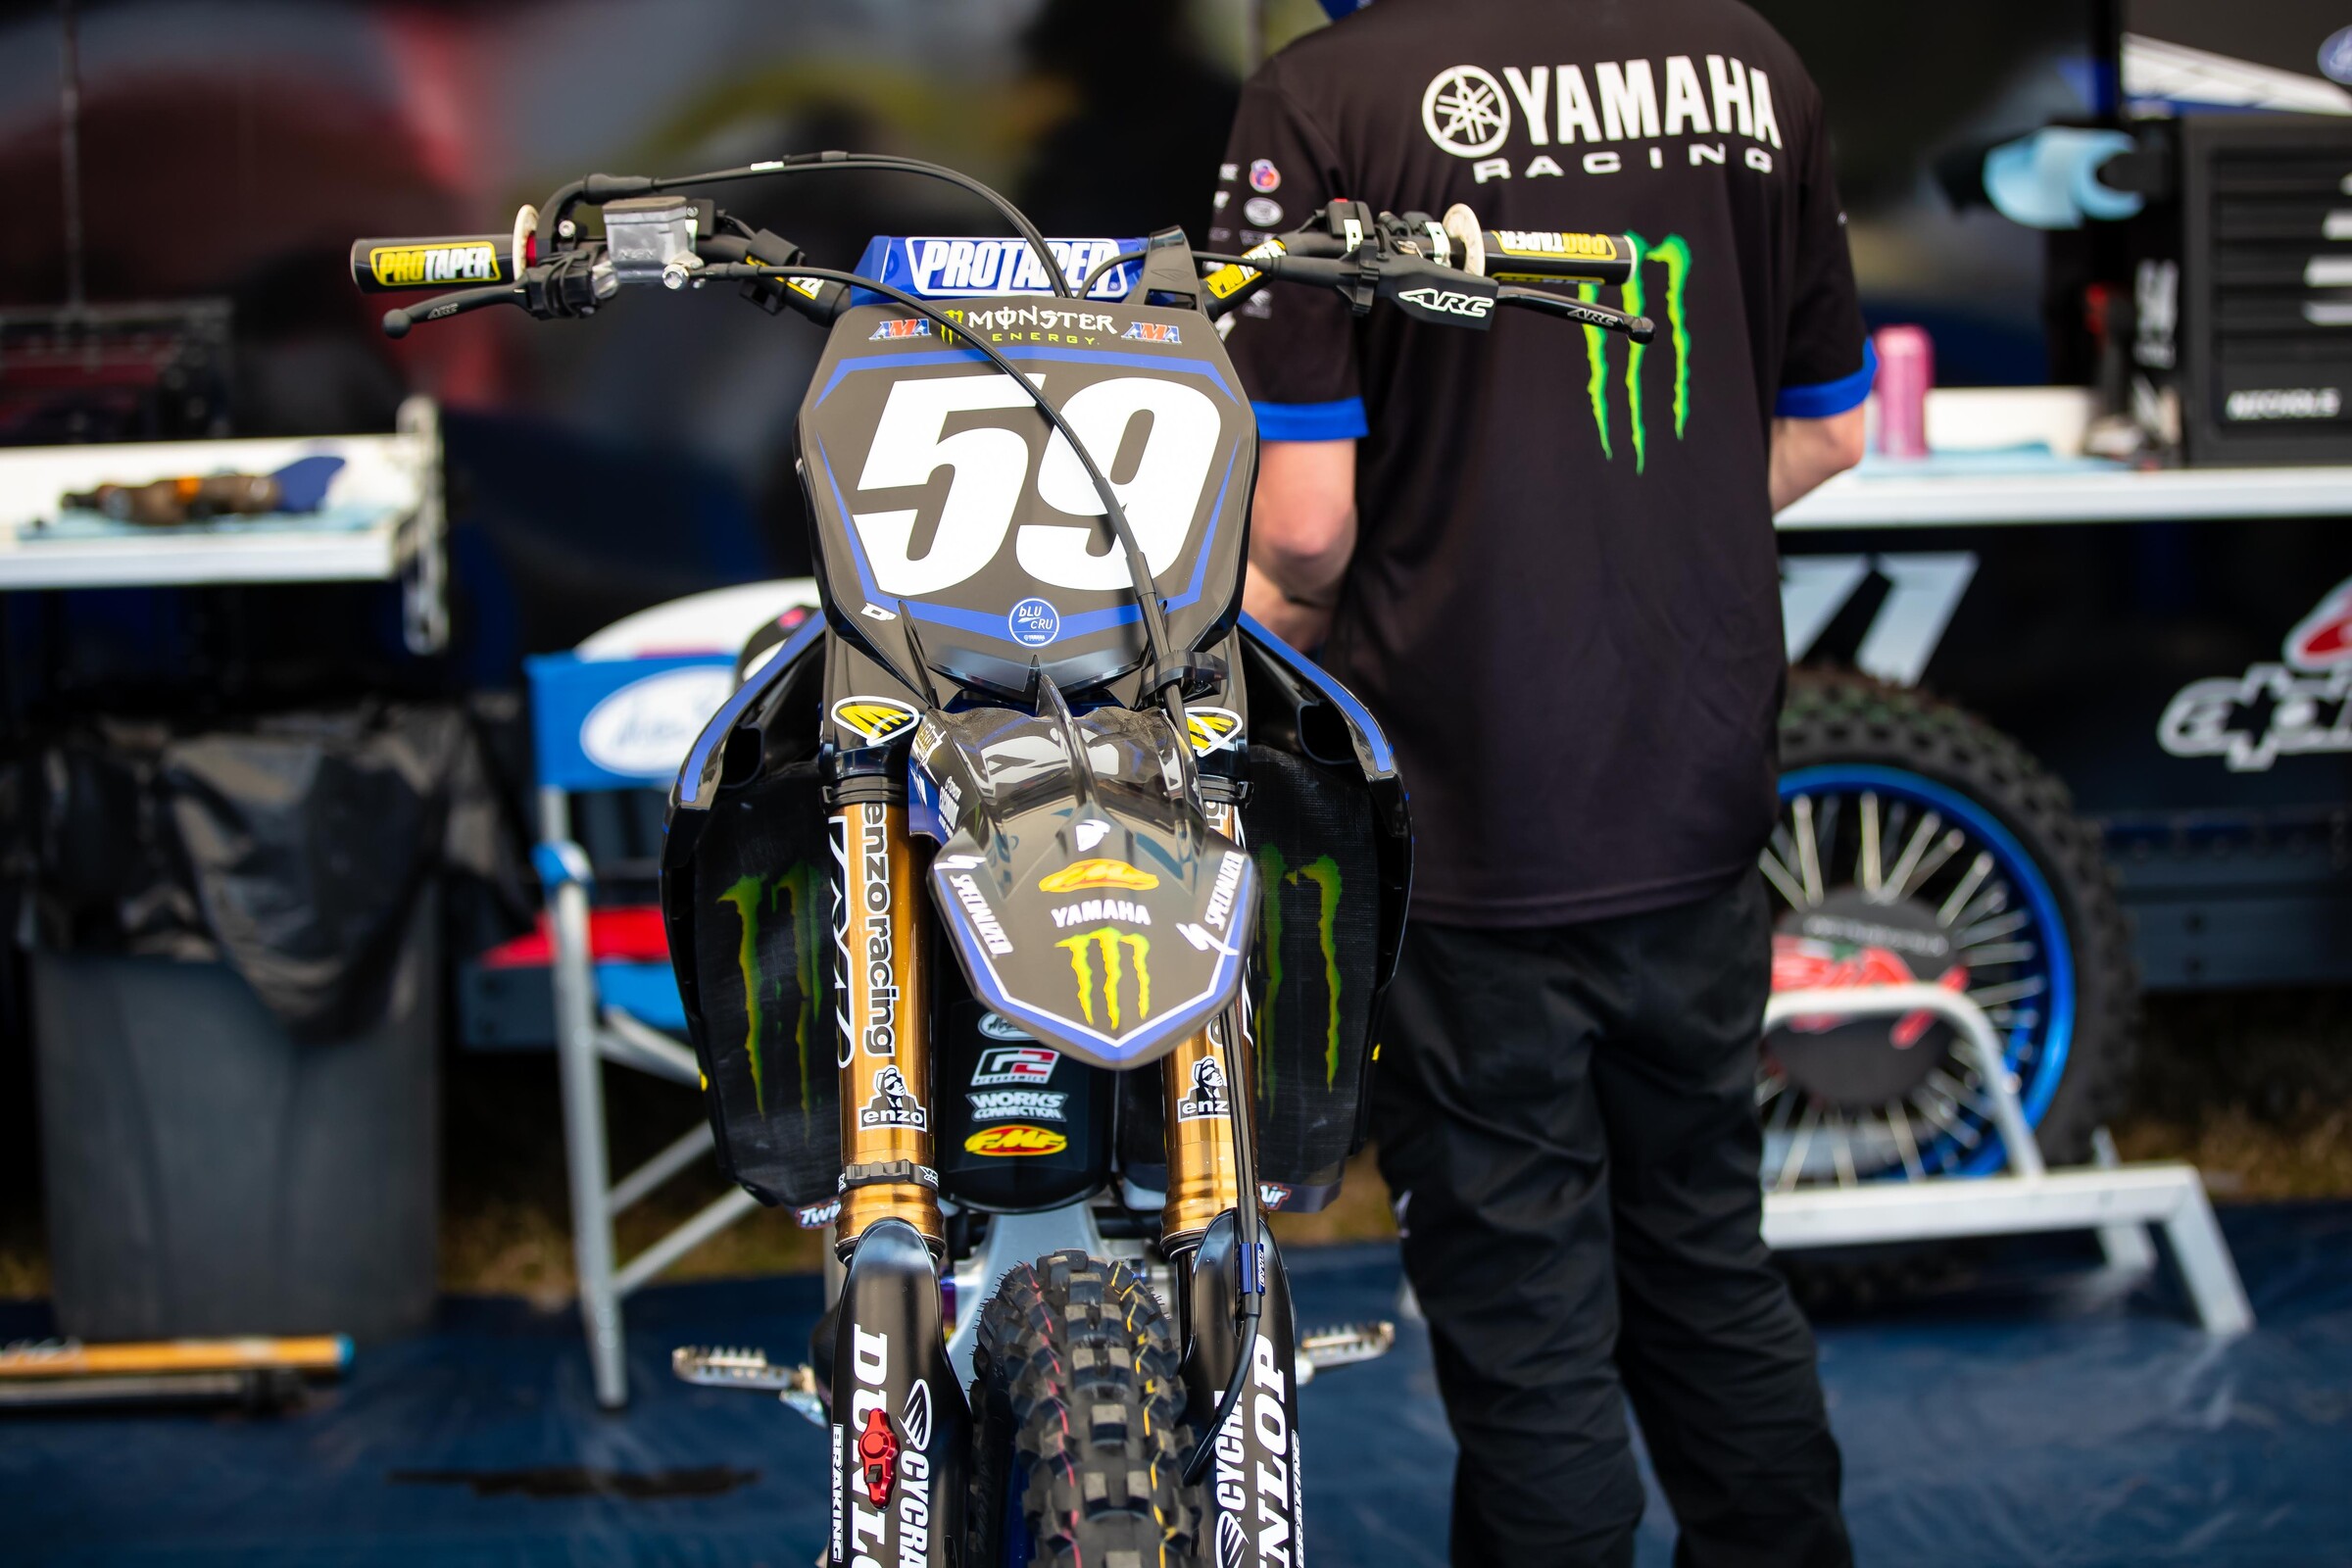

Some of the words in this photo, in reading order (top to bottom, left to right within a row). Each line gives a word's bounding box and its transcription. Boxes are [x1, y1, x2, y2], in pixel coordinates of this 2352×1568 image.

[1502, 54, 1783, 149] YAMAHA
[1472, 142, 1774, 184] RACING
[377, 247, 492, 283] PROTAPER
[918, 241, 1120, 291] PROTAPER
[426, 302, 459, 319] ARC
[1398, 288, 1494, 317] ARC
[869, 318, 931, 341] AMA
[967, 306, 1118, 335] MONSTER
[1567, 308, 1620, 327] ARC
[992, 332, 1096, 346] ENERGY
[1121, 321, 1183, 345] AMA
[853, 372, 1222, 597] 59
[1051, 899, 1152, 928] YAMAHA
[863, 804, 900, 1057] enzoracing
[970, 1091, 1064, 1108] WORKS
[973, 1107, 1062, 1119] CONNECTION
[1181, 1099, 1230, 1114] enz
[862, 1109, 923, 1125] enzo
[964, 1129, 1067, 1152] FMF
[833, 1426, 843, 1562] BRAKING
[899, 1449, 930, 1568] CYCRA
